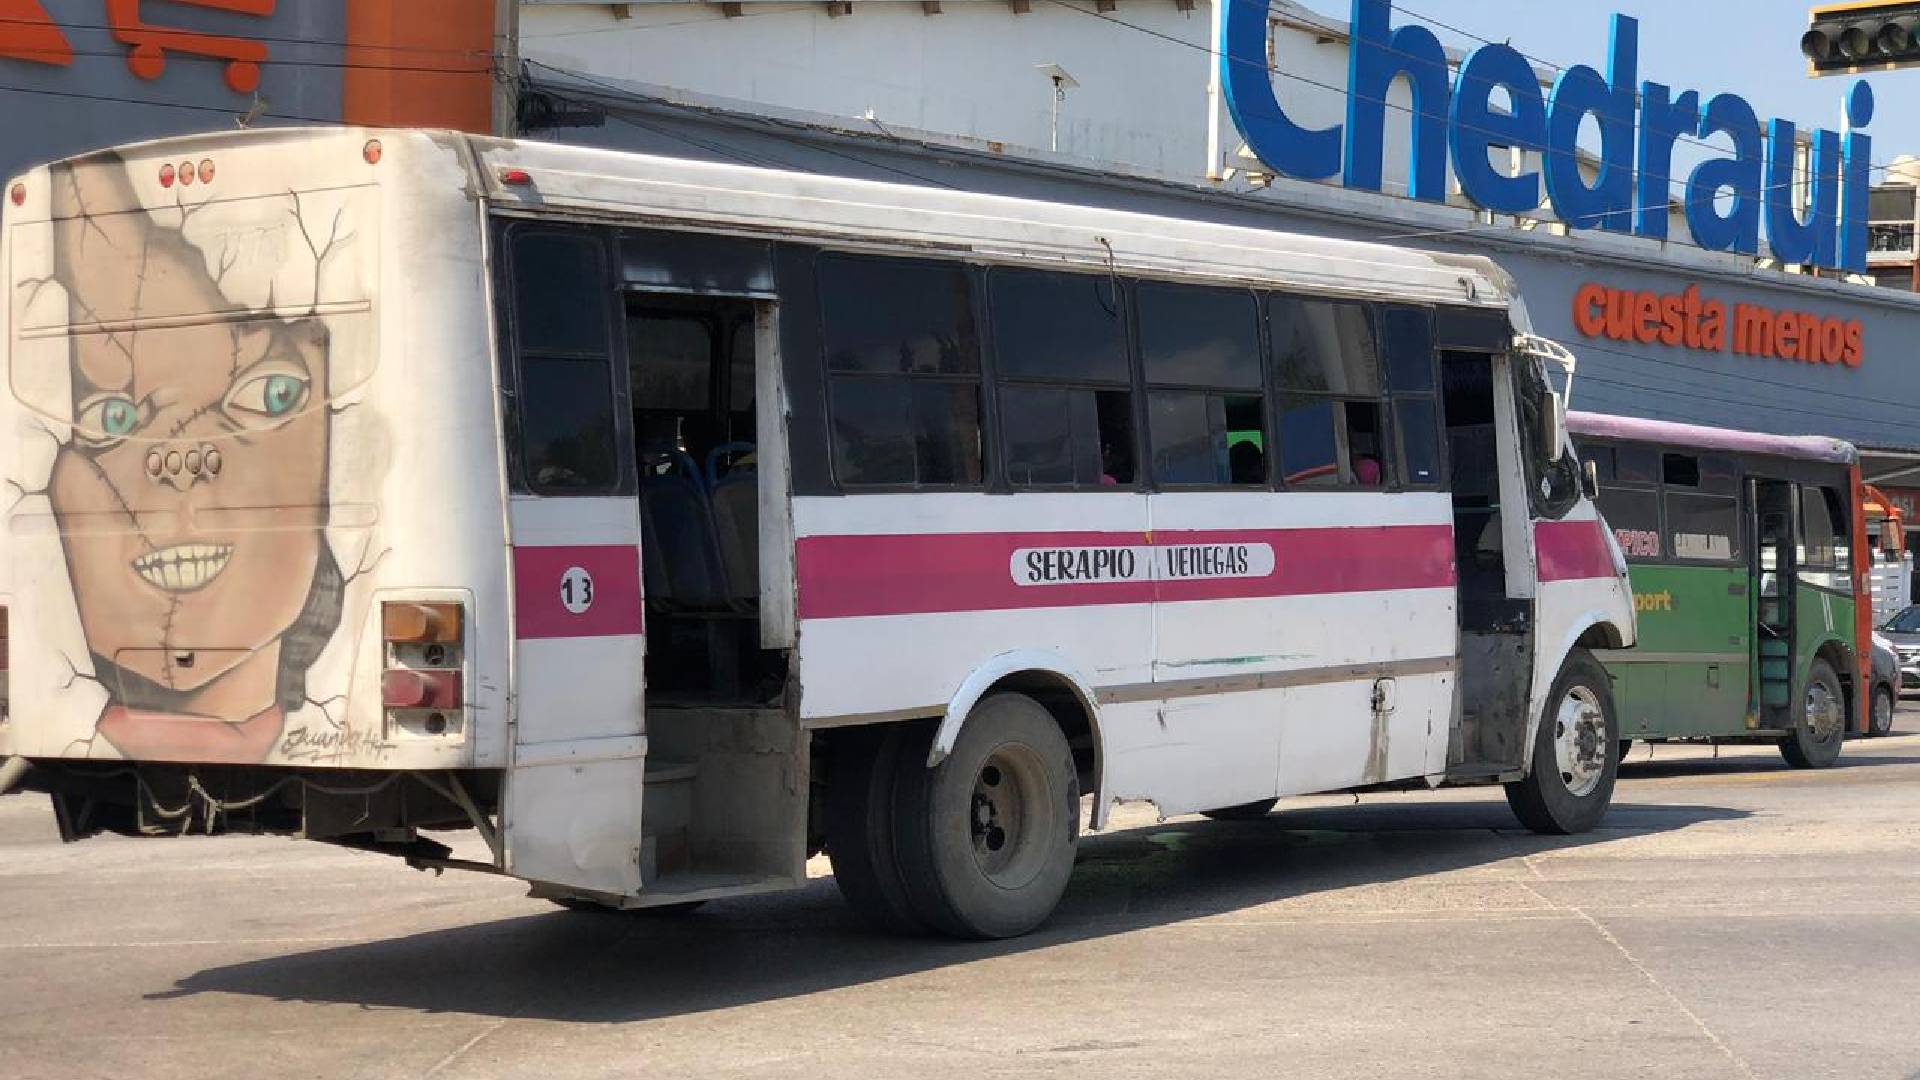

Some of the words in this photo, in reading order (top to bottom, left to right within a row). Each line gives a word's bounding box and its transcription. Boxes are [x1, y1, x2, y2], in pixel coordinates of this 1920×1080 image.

[1220, 0, 1873, 274] Chedraui
[1573, 282, 1727, 351] cuesta
[1733, 301, 1864, 368] menos
[562, 577, 592, 604] 13
[1026, 548, 1135, 582] SERAPIO
[1167, 545, 1248, 576] VENEGAS
